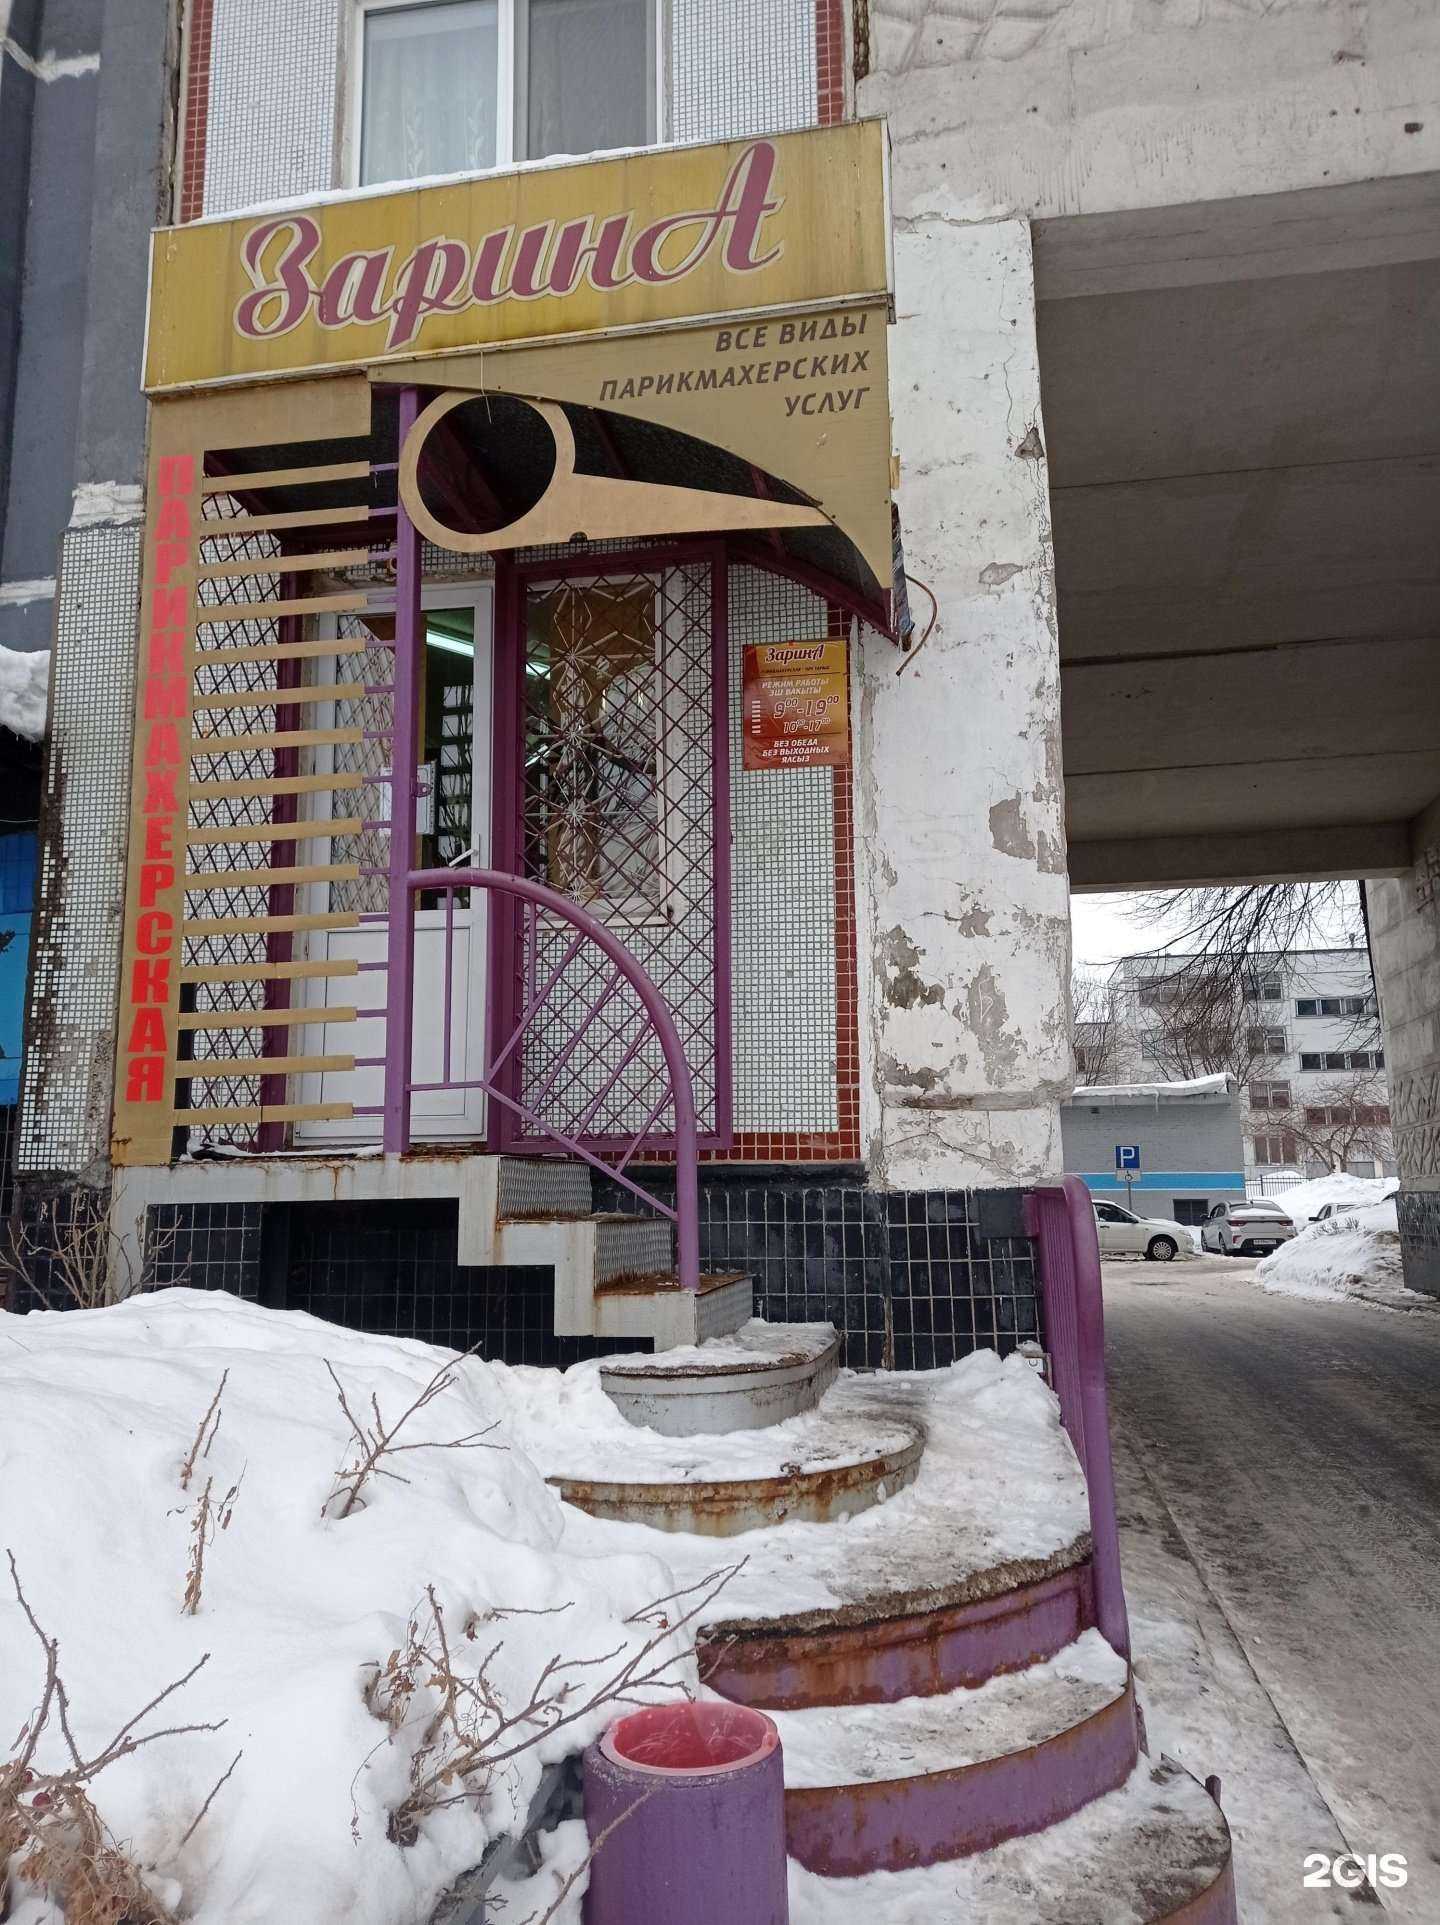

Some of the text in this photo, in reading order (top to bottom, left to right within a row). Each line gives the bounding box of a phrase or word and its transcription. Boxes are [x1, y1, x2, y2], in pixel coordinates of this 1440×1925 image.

[715, 313, 868, 353] ВСЕ ВИДЫ
[600, 350, 871, 401] ПАРИКМАХЕРСКИХ
[785, 387, 871, 417] УСЛУГ
[762, 679, 830, 689] РЕЖИМ РАБОТЫ
[762, 746, 830, 757] БЕЗ ВЫХОДНЫХ
[773, 738, 818, 748] БЕЗ ОБЕДА
[125, 454, 196, 1102] ПАРИКМАХЕРСКАЯ
